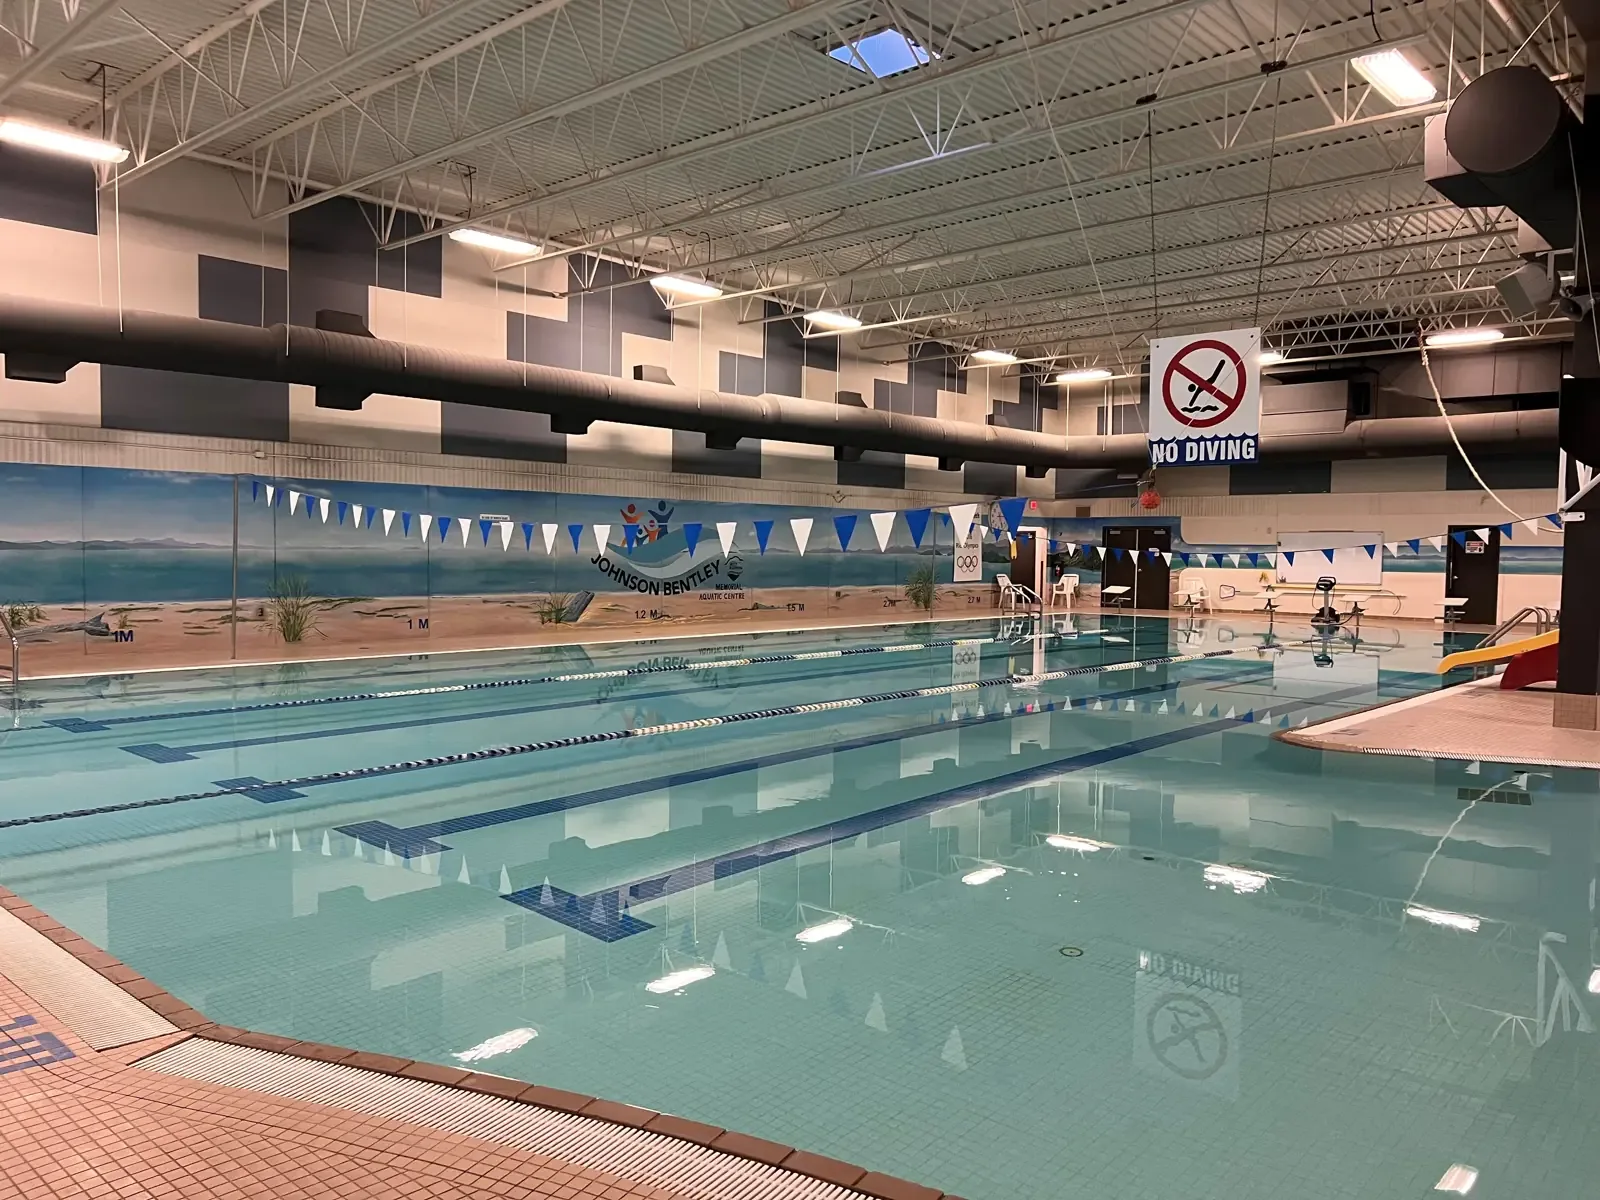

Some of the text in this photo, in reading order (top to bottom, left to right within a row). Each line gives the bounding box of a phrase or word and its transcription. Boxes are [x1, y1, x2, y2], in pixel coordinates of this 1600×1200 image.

[1152, 438, 1255, 463] NO DIVING
[590, 554, 720, 596] JOHNSON BENTLEY
[715, 583, 743, 591] MEMORIAL
[699, 592, 745, 601] AQUATIC CENTRE
[418, 618, 429, 629] M
